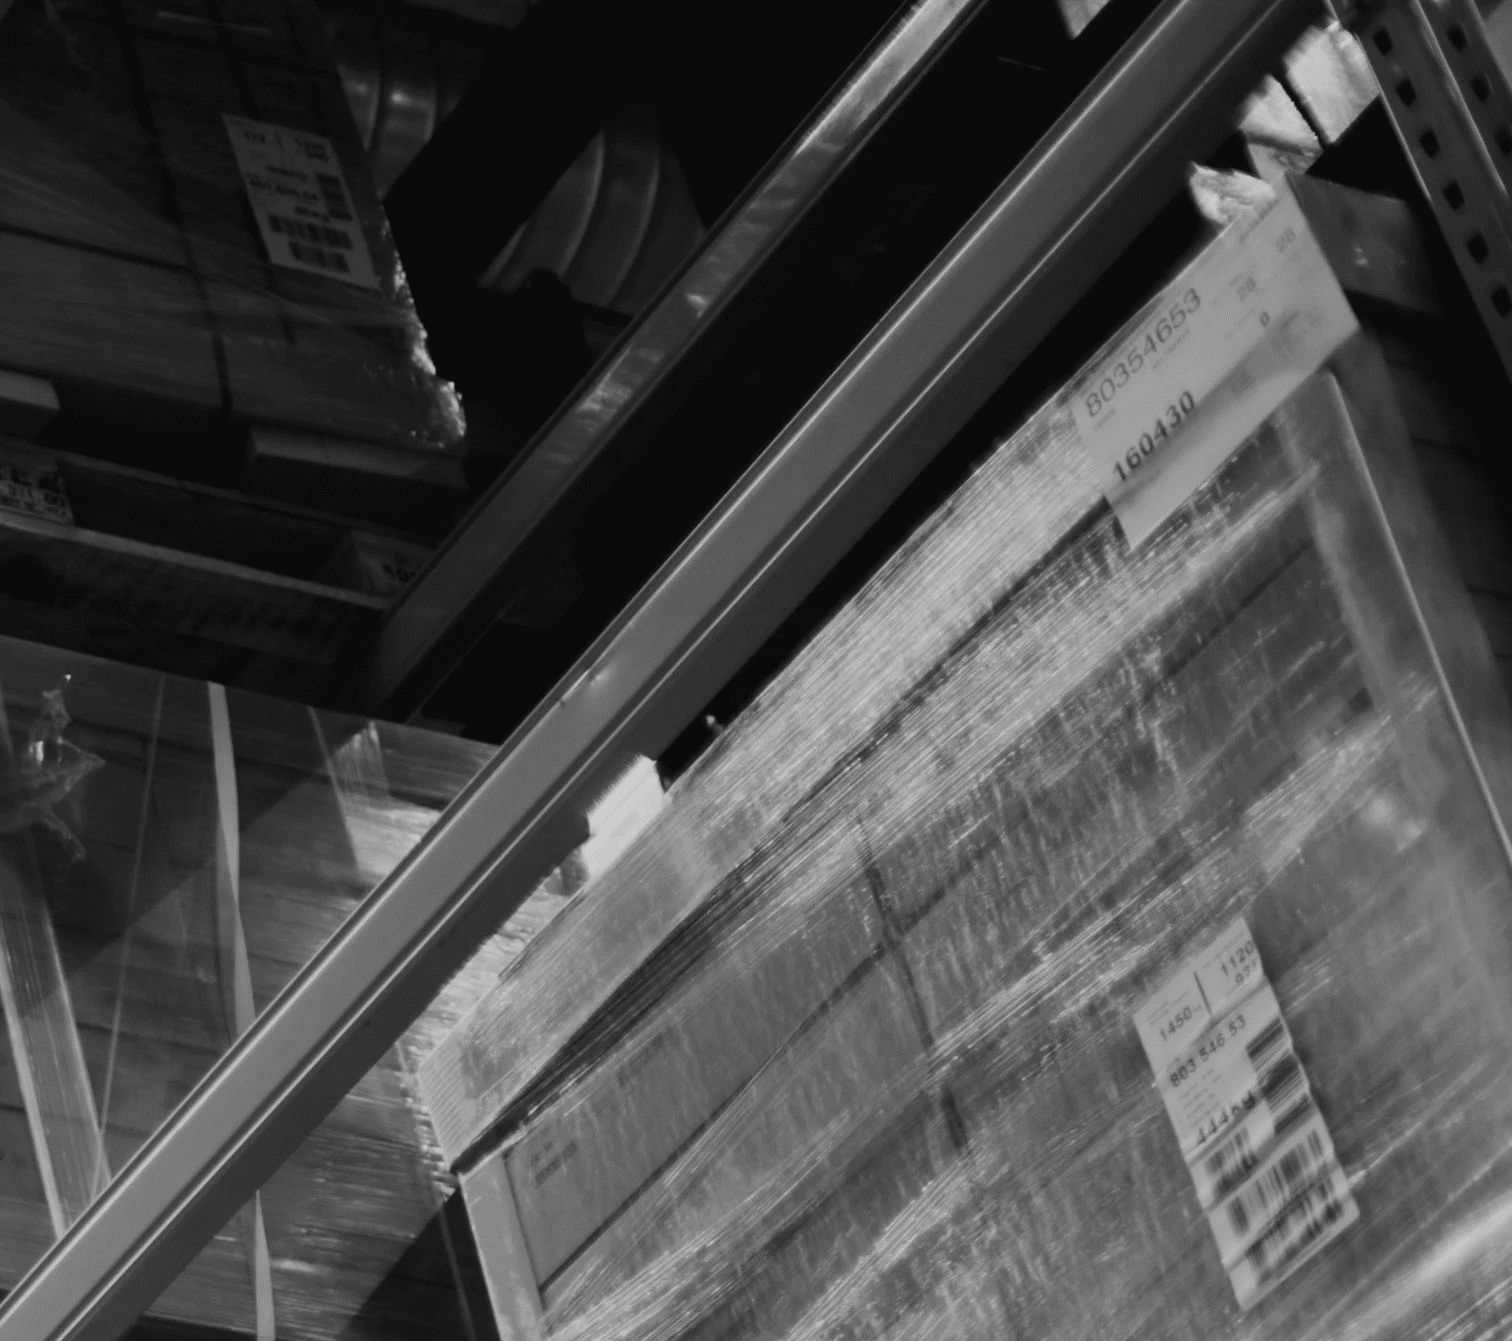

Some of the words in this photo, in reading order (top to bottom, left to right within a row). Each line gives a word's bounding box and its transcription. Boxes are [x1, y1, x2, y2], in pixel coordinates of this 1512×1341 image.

[1083, 287, 1202, 418] 80354653
[1114, 390, 1196, 482] 160430
[1158, 1005, 1194, 1042] 1450
[1168, 1014, 1248, 1088] 803.546.53
